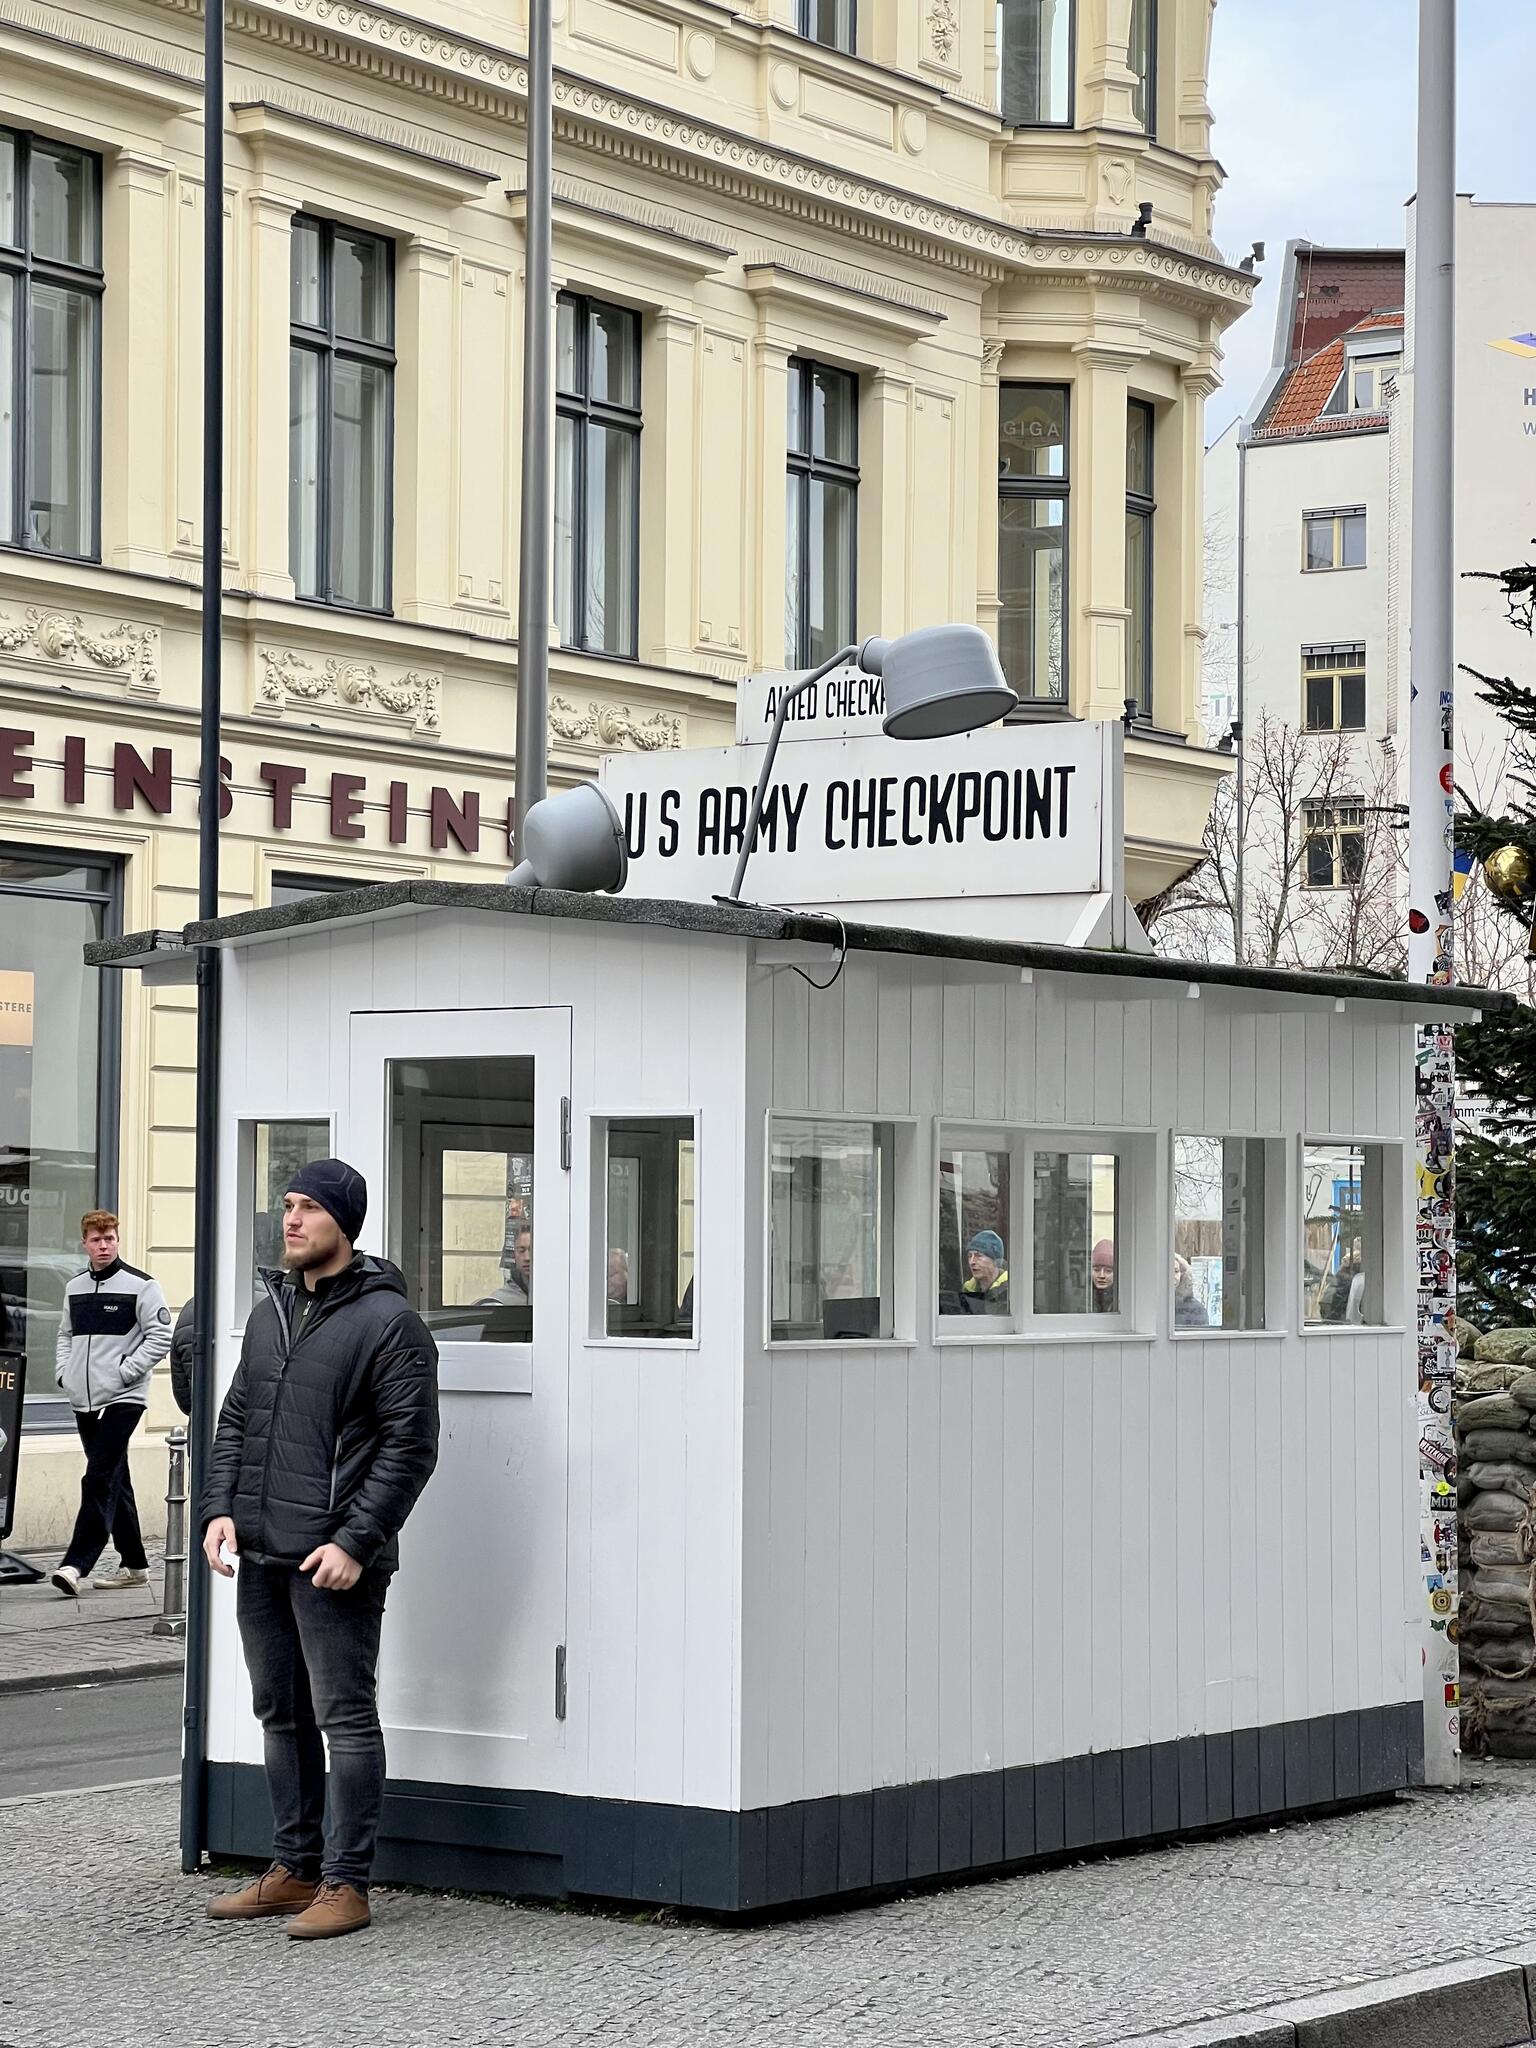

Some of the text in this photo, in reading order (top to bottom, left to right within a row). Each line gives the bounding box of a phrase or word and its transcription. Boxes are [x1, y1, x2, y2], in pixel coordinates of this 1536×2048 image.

[1003, 421, 1060, 437] GIGA
[624, 765, 1076, 859] U S ARMY CHECKPOINT
